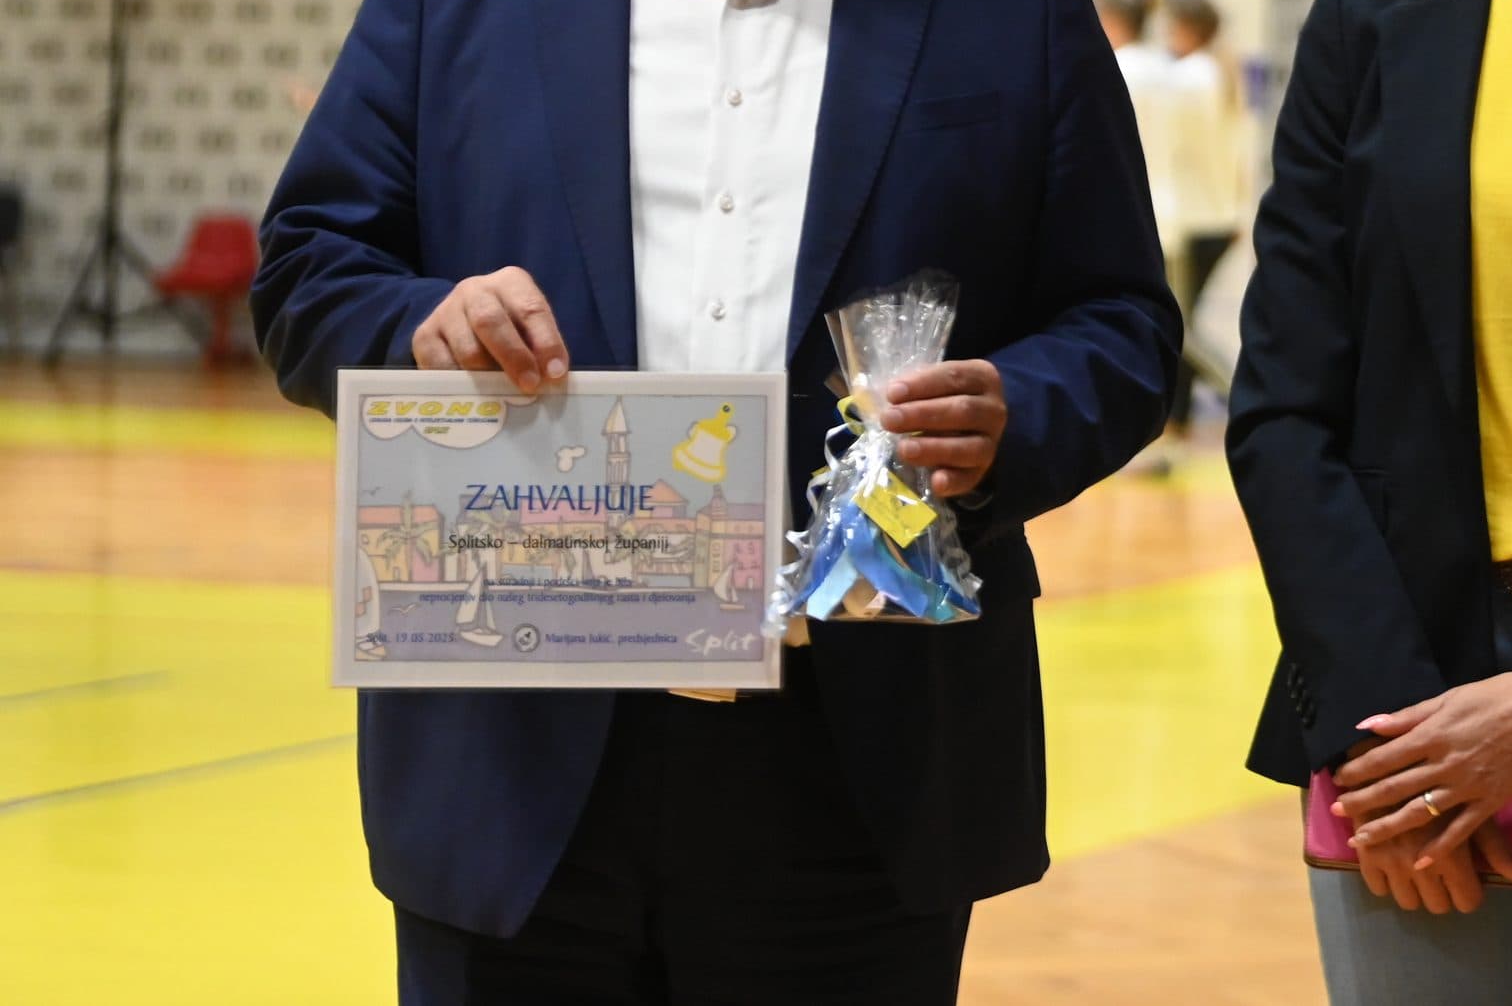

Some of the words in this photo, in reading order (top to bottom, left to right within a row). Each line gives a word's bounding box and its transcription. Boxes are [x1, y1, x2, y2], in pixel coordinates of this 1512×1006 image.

[366, 400, 502, 416] ZVONO
[464, 484, 655, 515] ZAHVALJUJE
[448, 533, 503, 554] Splitsko
[522, 533, 610, 554] dalmatinskoj
[615, 533, 670, 554] županiji
[685, 628, 757, 658] Split
